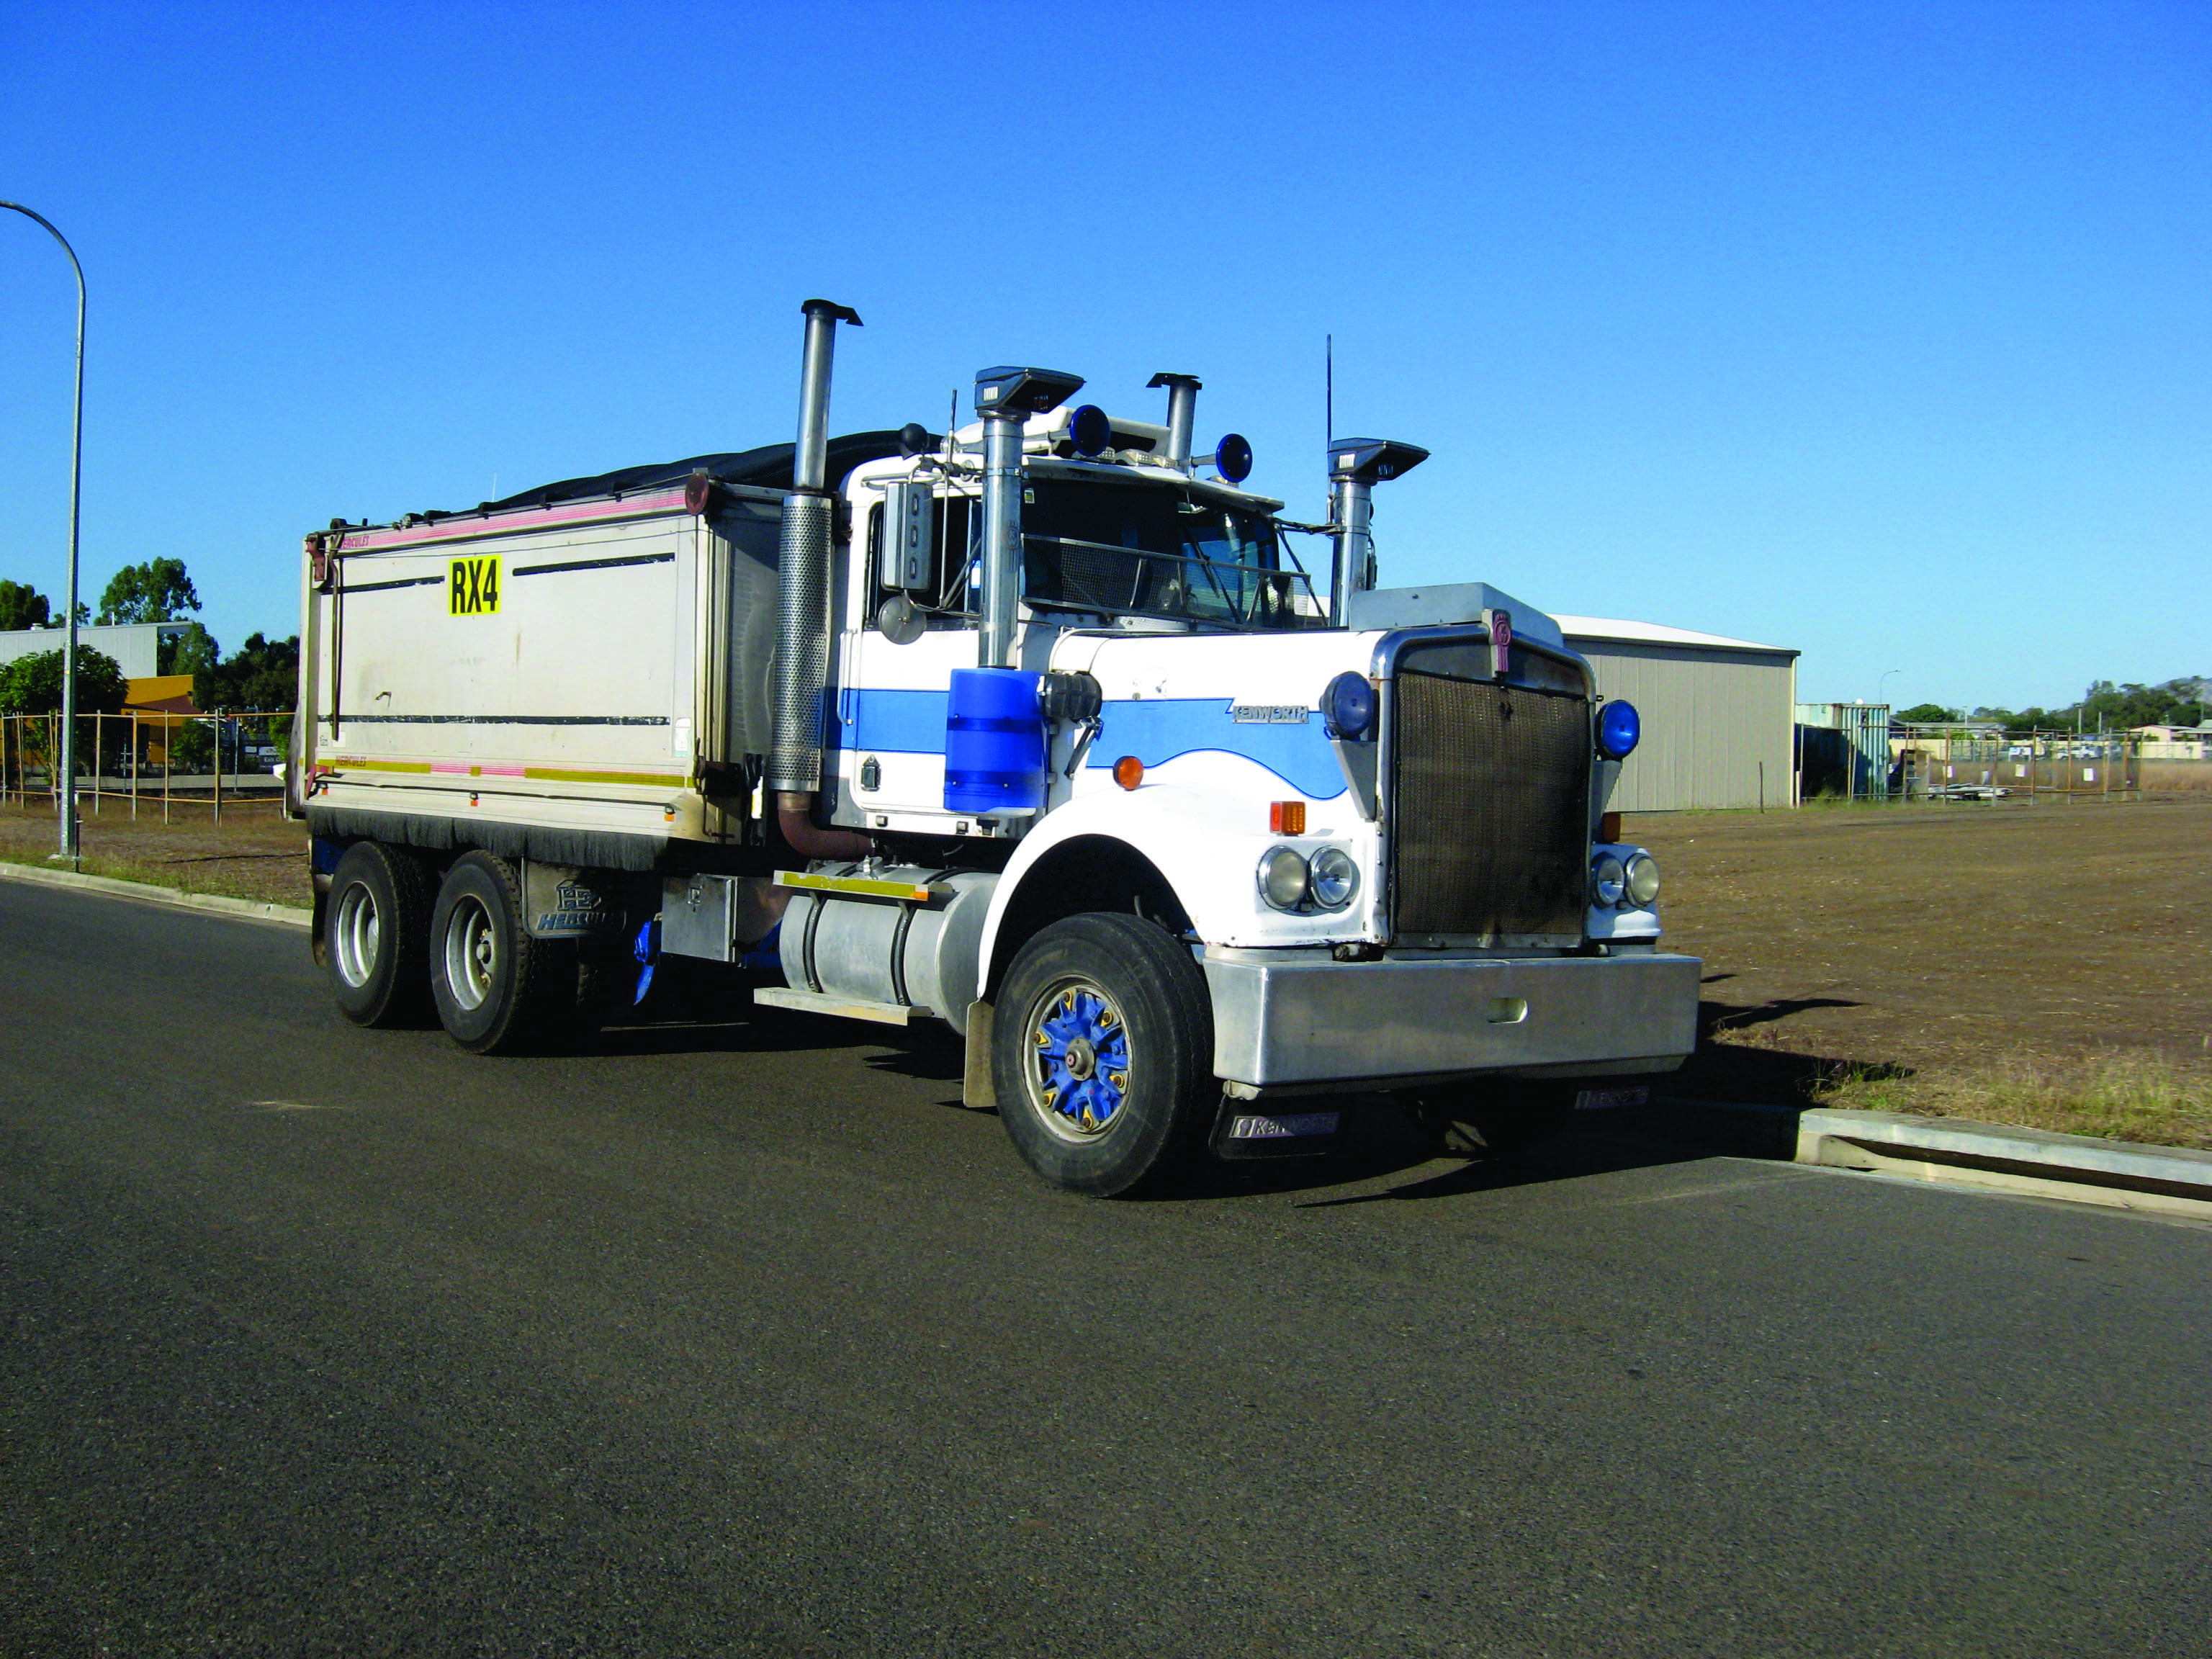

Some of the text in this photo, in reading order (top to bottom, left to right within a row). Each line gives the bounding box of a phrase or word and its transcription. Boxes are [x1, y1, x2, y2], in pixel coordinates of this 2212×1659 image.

[452, 559, 498, 613] RX4
[1233, 706, 1309, 719] KENWORTH
[535, 912, 621, 930] HERCUL
